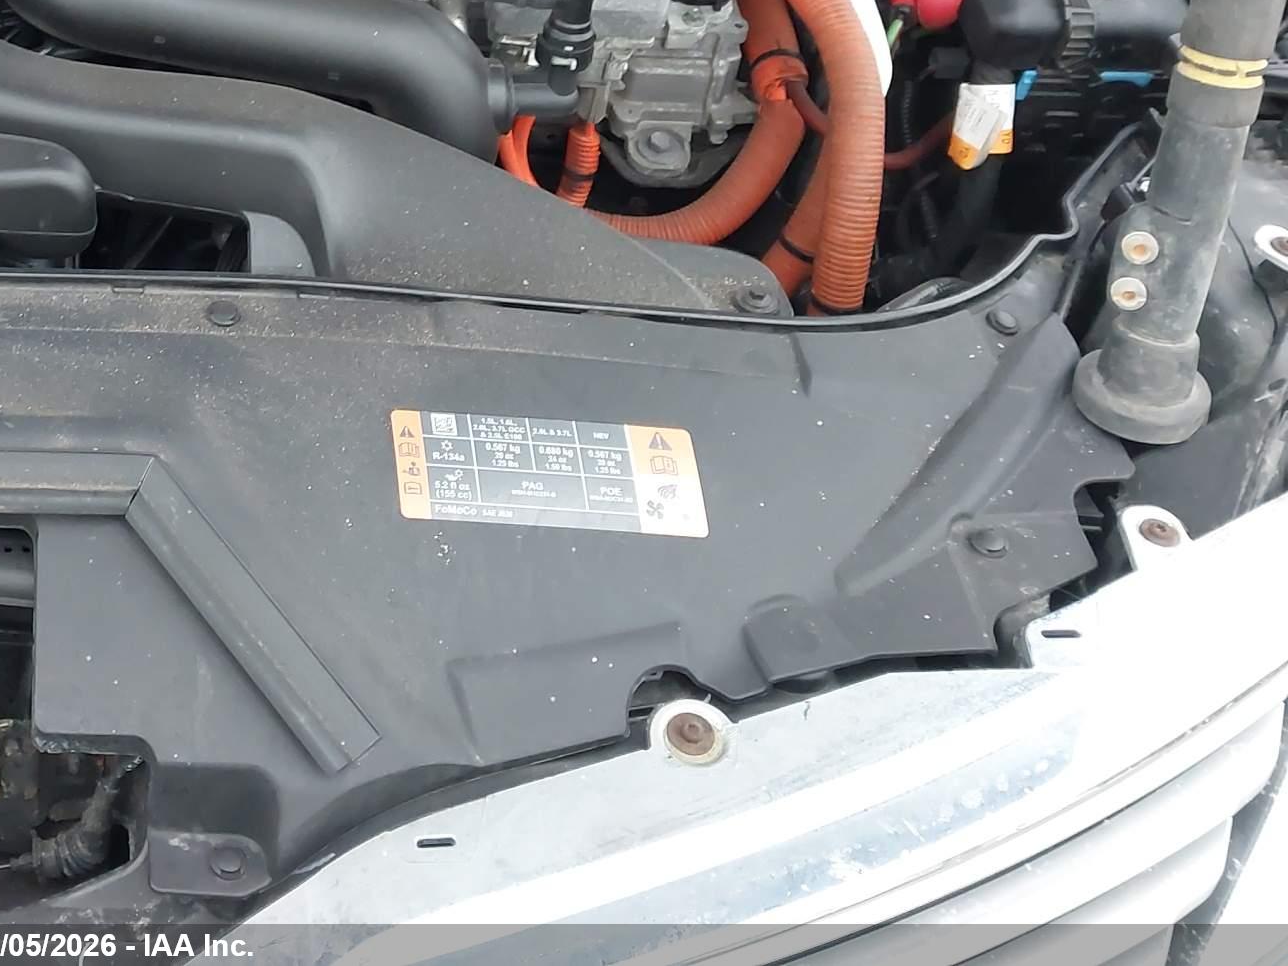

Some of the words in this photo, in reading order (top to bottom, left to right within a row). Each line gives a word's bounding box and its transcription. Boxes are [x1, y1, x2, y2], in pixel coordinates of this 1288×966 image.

[485, 442, 507, 452] 0.567
[509, 444, 520, 454] kg
[562, 448, 574, 458] kg
[432, 452, 465, 462] R-134a
[610, 452, 622, 462] kg
[508, 460, 520, 468] lbs
[561, 464, 572, 472] lbs
[434, 481, 448, 489] 5.2
[521, 481, 544, 490] PAG
[436, 490, 456, 499] (155
[458, 491, 472, 500] cc)
[600, 486, 623, 496] POE
[435, 504, 477, 516] FoMoCo
